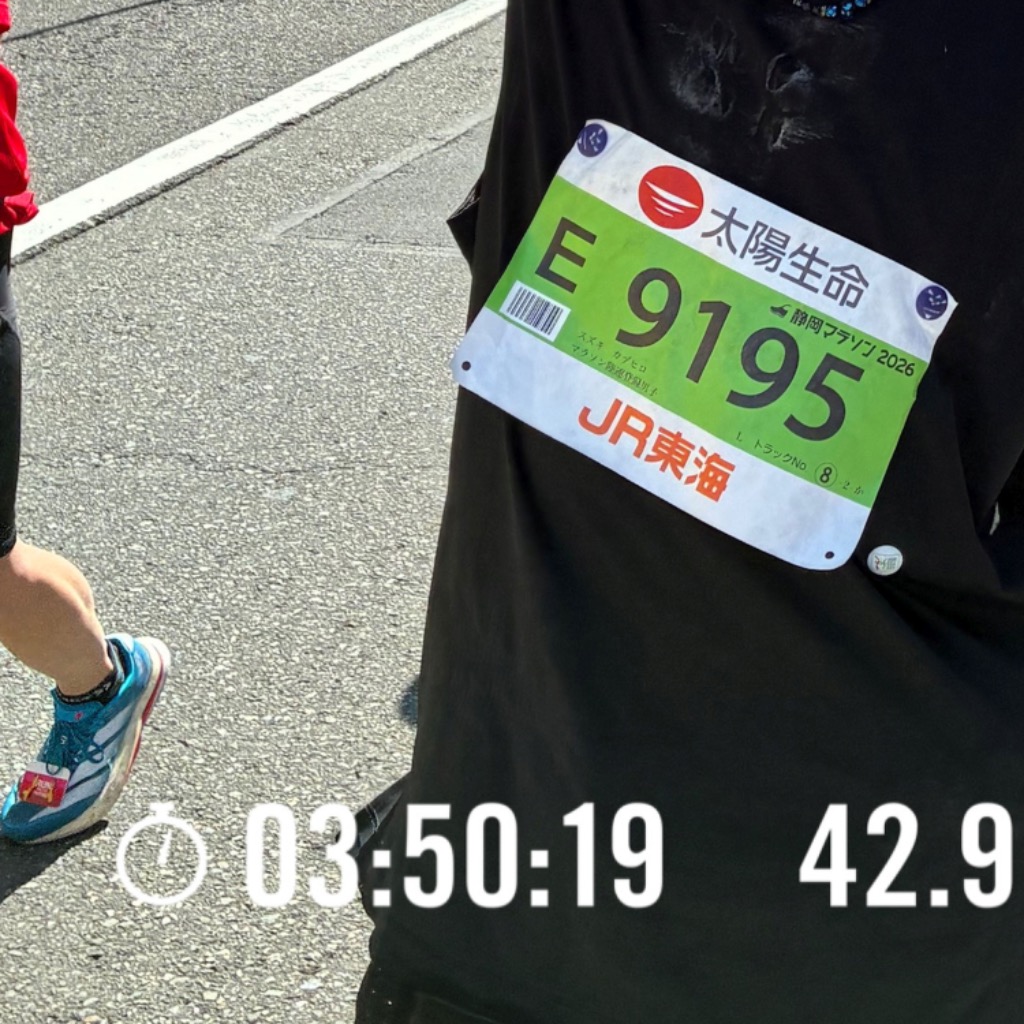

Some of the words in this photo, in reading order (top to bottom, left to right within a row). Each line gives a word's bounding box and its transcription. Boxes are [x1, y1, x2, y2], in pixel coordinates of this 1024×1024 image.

[701, 206, 870, 309] 太陽生命
[534, 216, 598, 294] E
[615, 267, 865, 441] 9195
[789, 308, 877, 358] 静岡マラソン
[876, 349, 915, 377] 2026
[578, 398, 736, 502] JR東海
